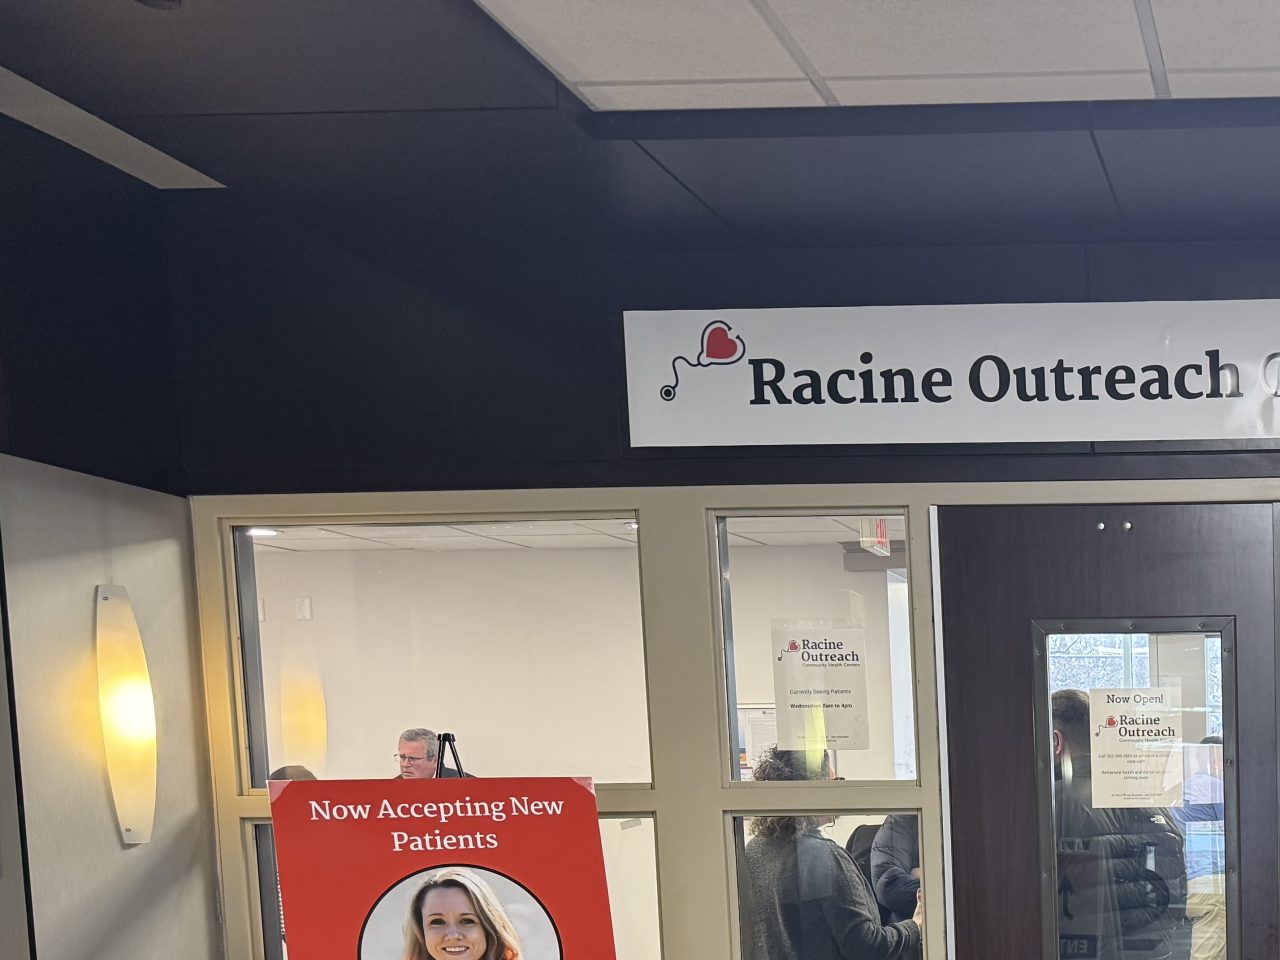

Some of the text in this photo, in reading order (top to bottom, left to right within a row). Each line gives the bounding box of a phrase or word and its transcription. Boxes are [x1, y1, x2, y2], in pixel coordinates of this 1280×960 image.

[748, 351, 954, 405] Racine
[967, 349, 1244, 402] Outreach
[801, 638, 860, 662] Racine Outreach
[1106, 693, 1164, 706] Now Open!
[1119, 713, 1161, 725] Racine
[1118, 726, 1176, 737] Outreach
[309, 796, 565, 823] Now Accepting New
[391, 829, 499, 852] Patients
